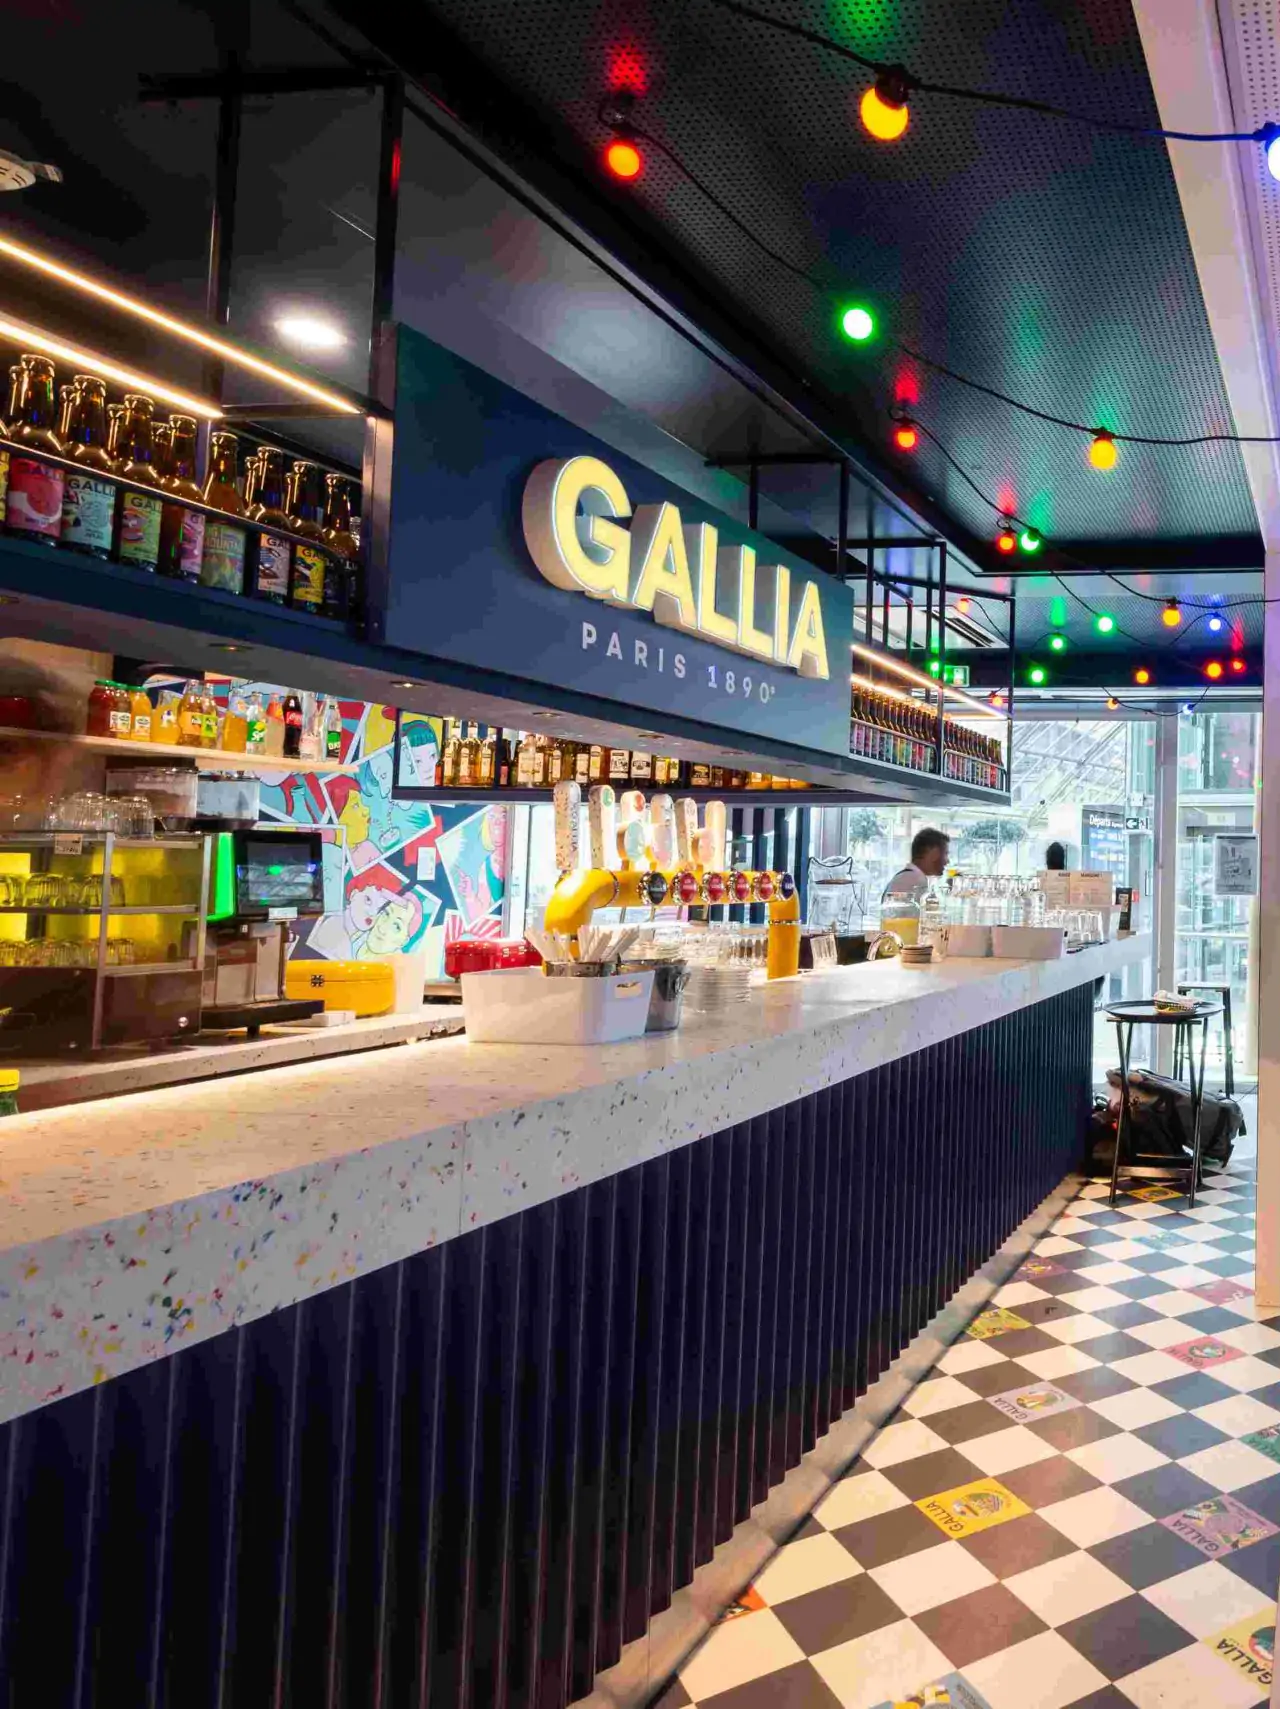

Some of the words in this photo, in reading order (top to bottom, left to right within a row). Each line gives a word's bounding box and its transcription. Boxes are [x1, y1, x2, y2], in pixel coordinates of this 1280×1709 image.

[523, 456, 829, 680] GALLIA
[581, 621, 687, 679] PARIS
[994, 1397, 1028, 1420] GALLIA
[925, 1499, 965, 1532] GALLIA
[1171, 1519, 1220, 1553] GALLIA
[1217, 1637, 1273, 1685] GALLIA
